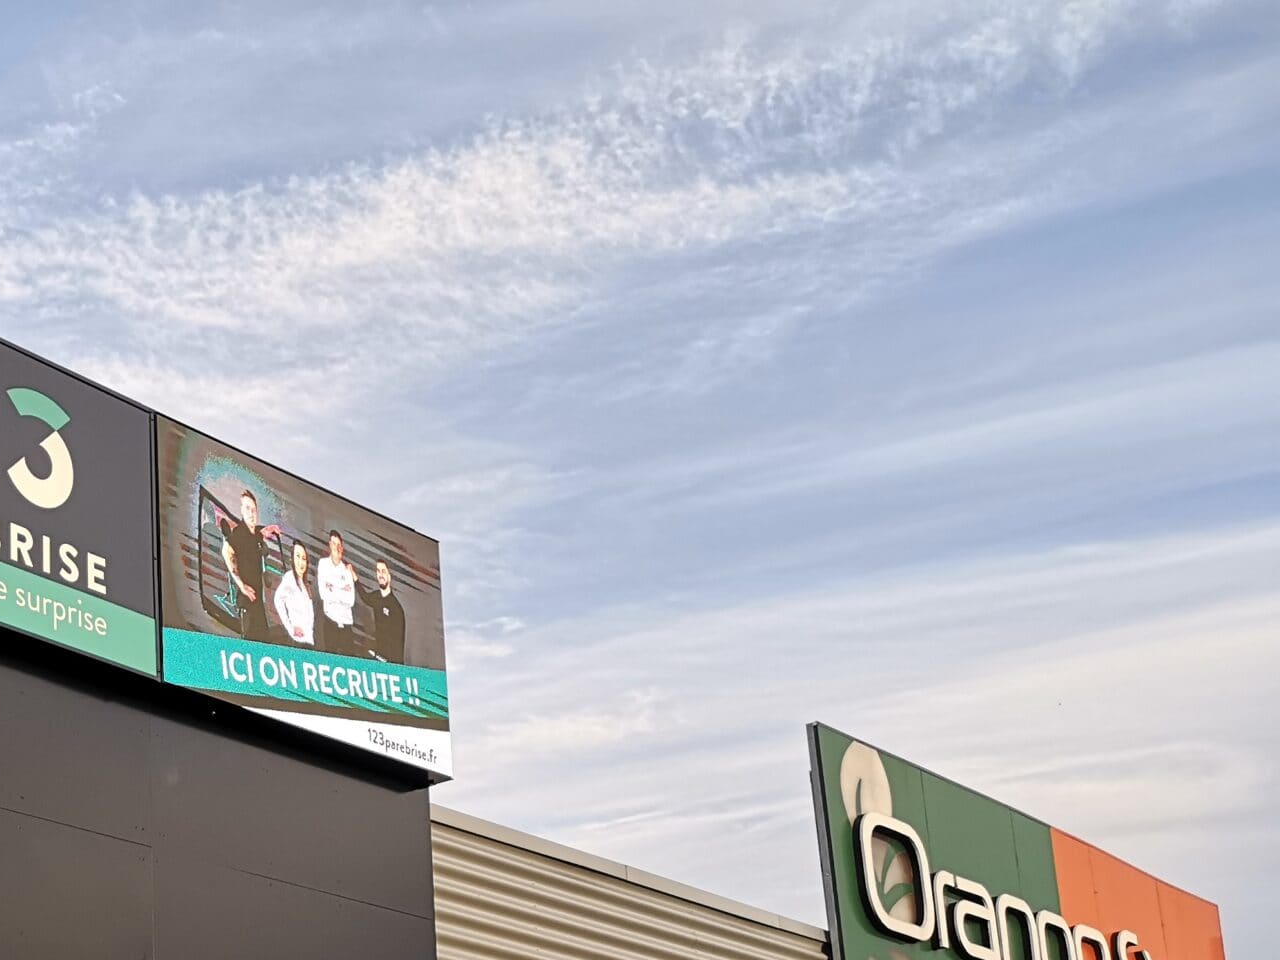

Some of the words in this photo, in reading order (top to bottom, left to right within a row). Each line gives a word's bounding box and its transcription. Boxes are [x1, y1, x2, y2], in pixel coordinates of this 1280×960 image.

[16, 587, 108, 636] surprise
[221, 650, 254, 683] ICI
[260, 656, 298, 689] ON
[303, 662, 403, 705] RECRUTE
[367, 728, 438, 765] 123parebrise.fr
